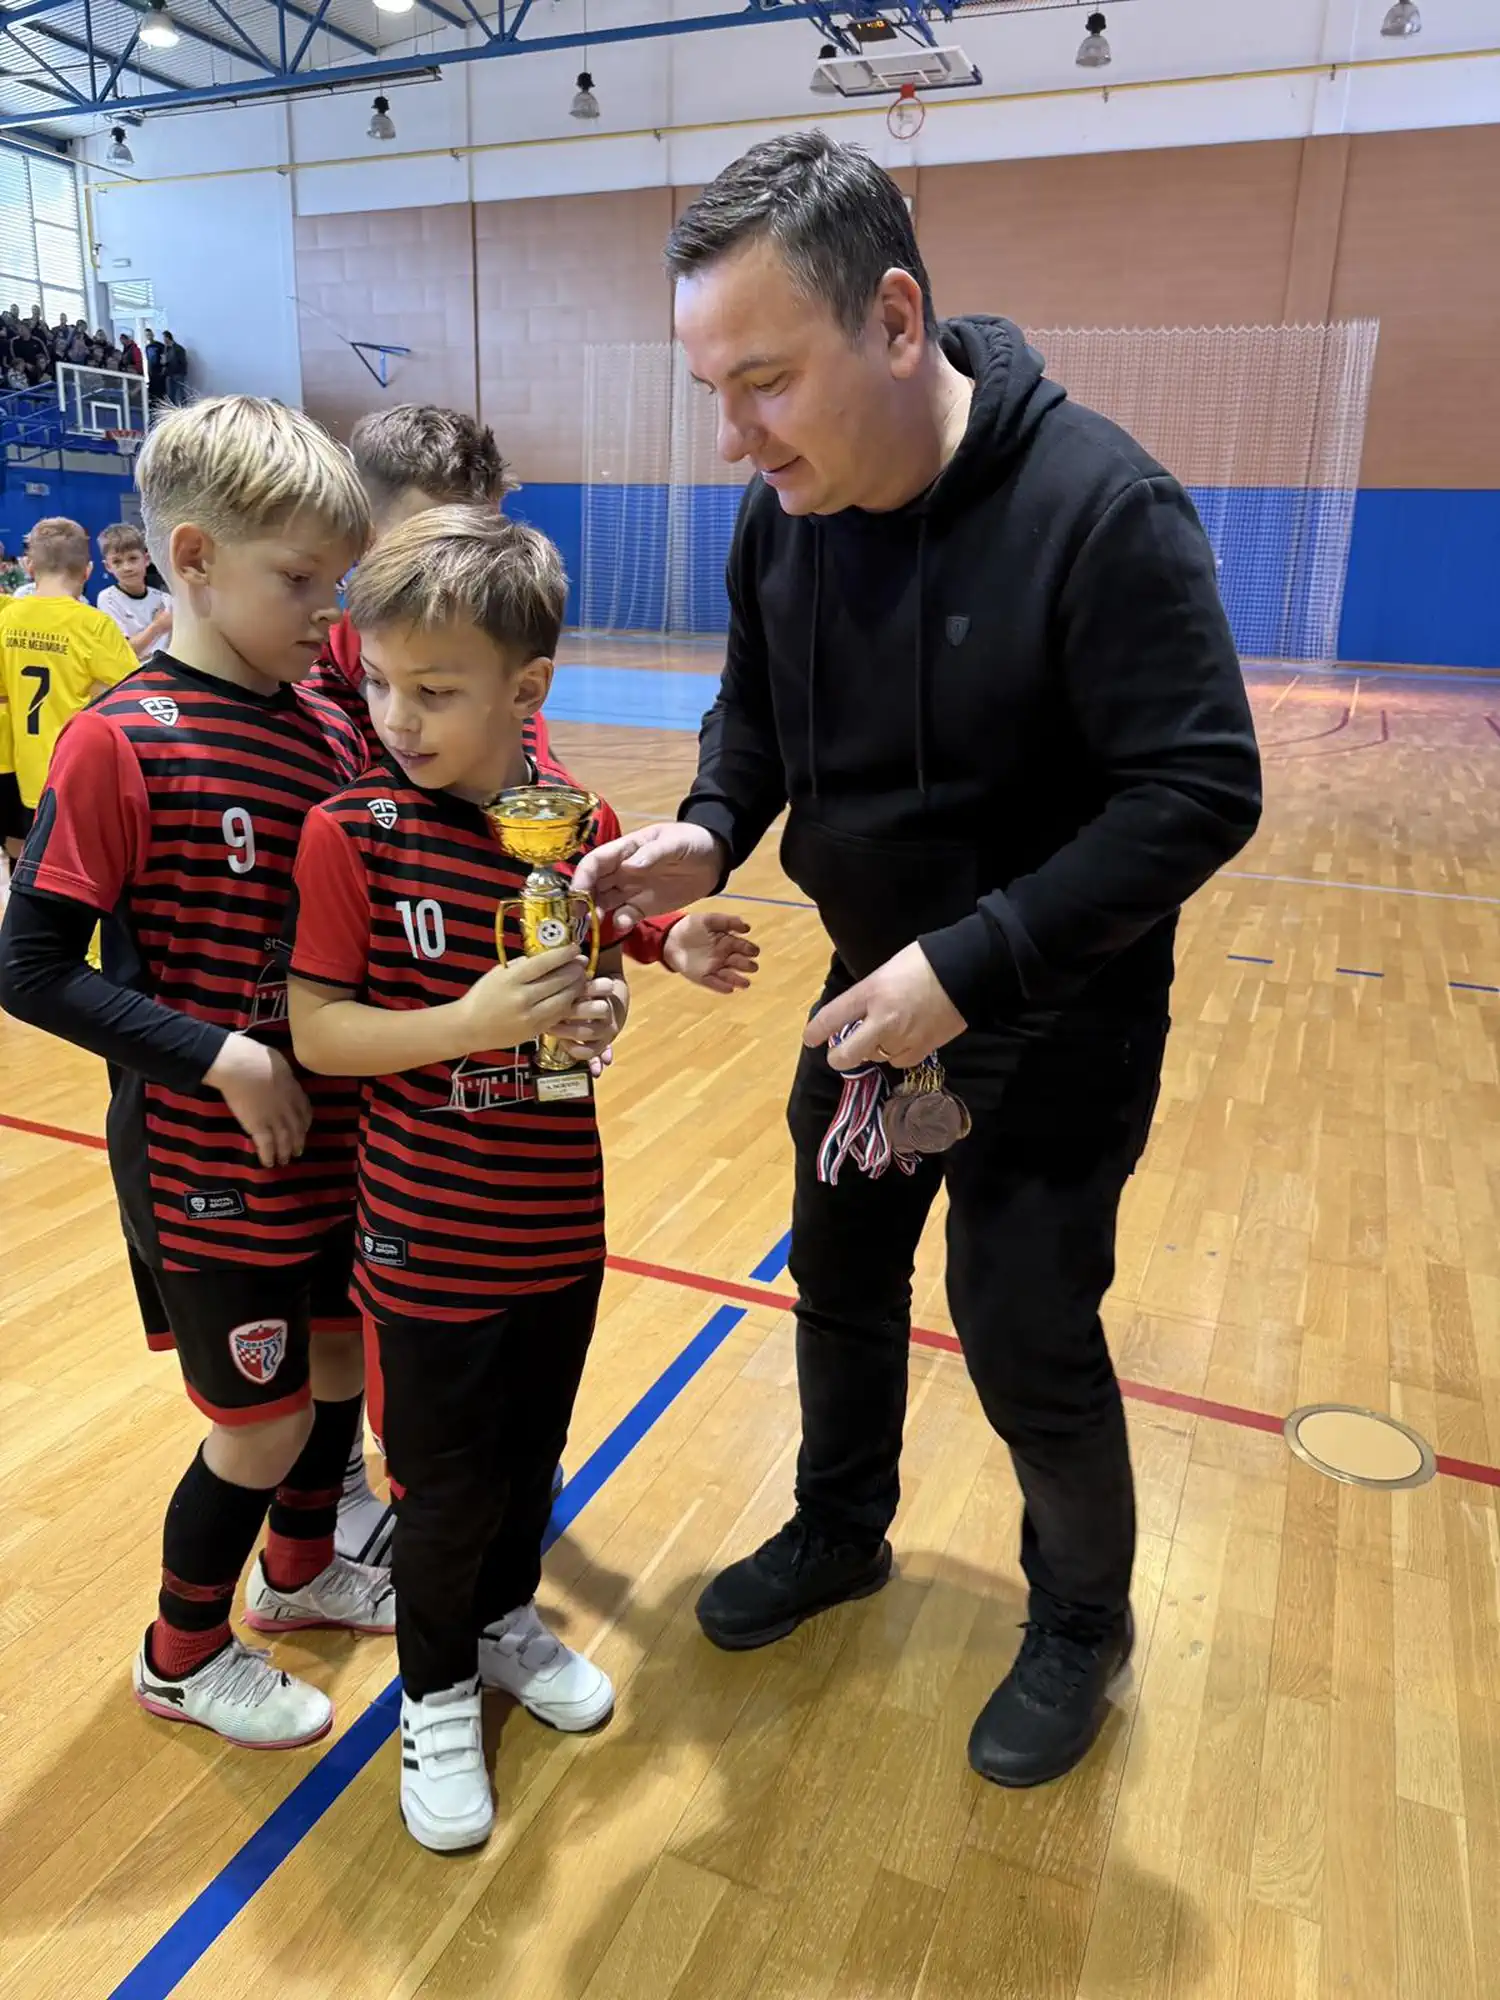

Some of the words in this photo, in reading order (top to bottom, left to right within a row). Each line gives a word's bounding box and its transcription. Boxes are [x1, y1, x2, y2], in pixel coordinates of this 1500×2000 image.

[21, 666, 50, 735] 7
[221, 806, 256, 874] 9
[395, 899, 446, 959] 10
